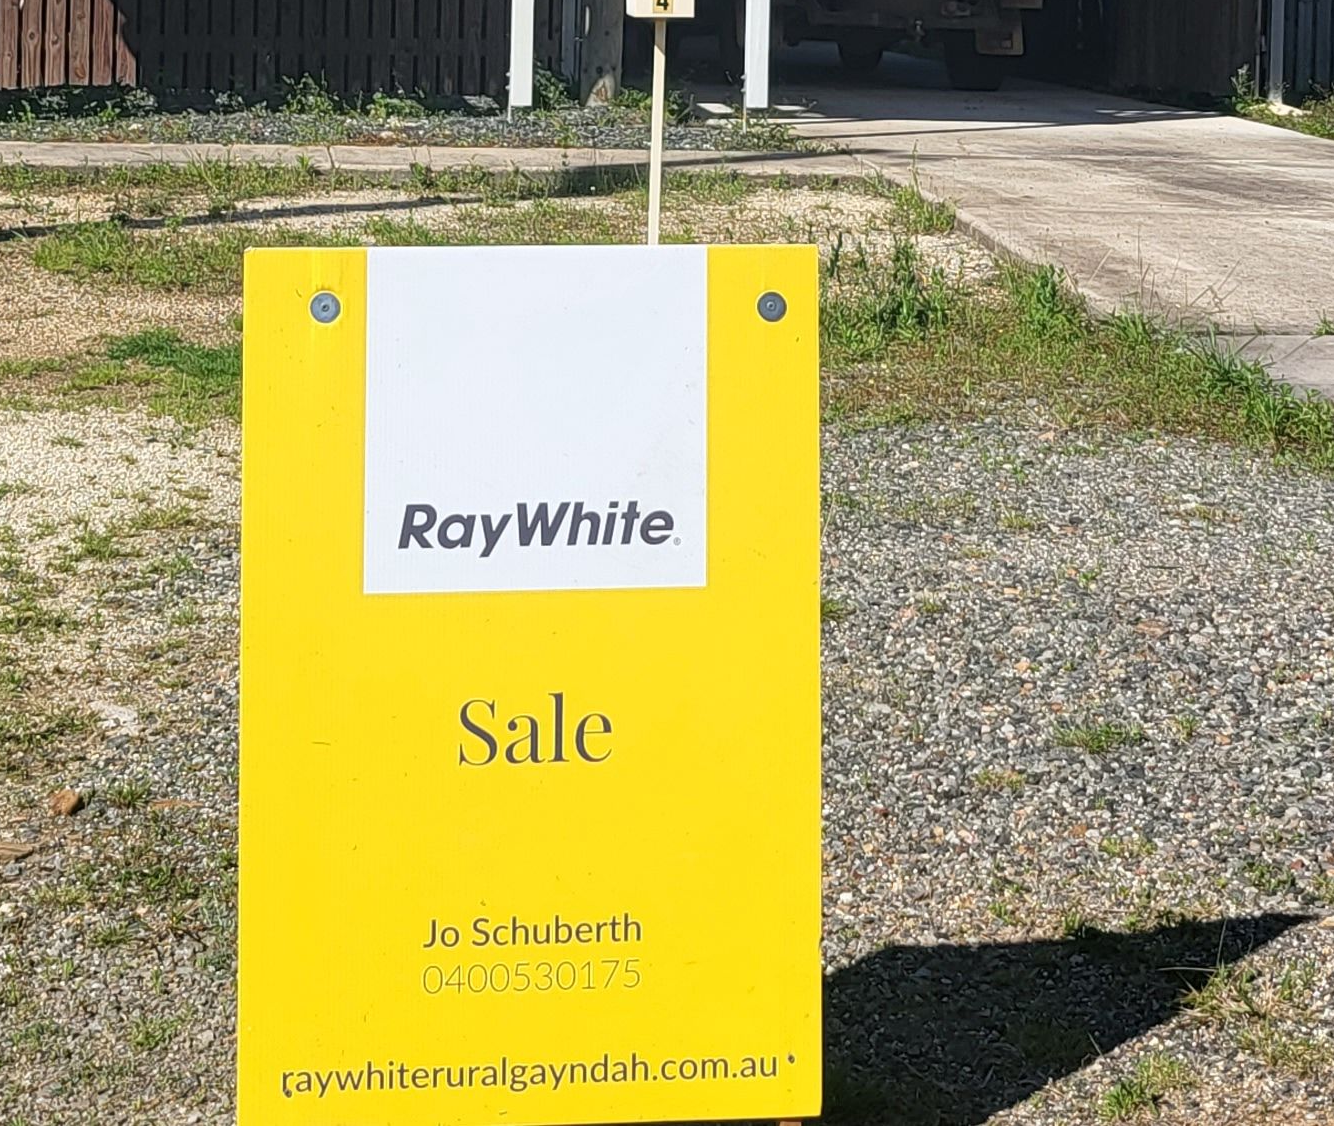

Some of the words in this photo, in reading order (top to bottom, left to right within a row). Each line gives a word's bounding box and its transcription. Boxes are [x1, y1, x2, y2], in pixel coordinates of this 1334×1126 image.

[459, 692, 612, 766] Sale
[423, 919, 460, 948] Jo
[472, 912, 642, 947] Schuberth
[423, 959, 641, 994] 0400530175
[282, 1052, 778, 1098] raywhiteruralgayndah.com.au
